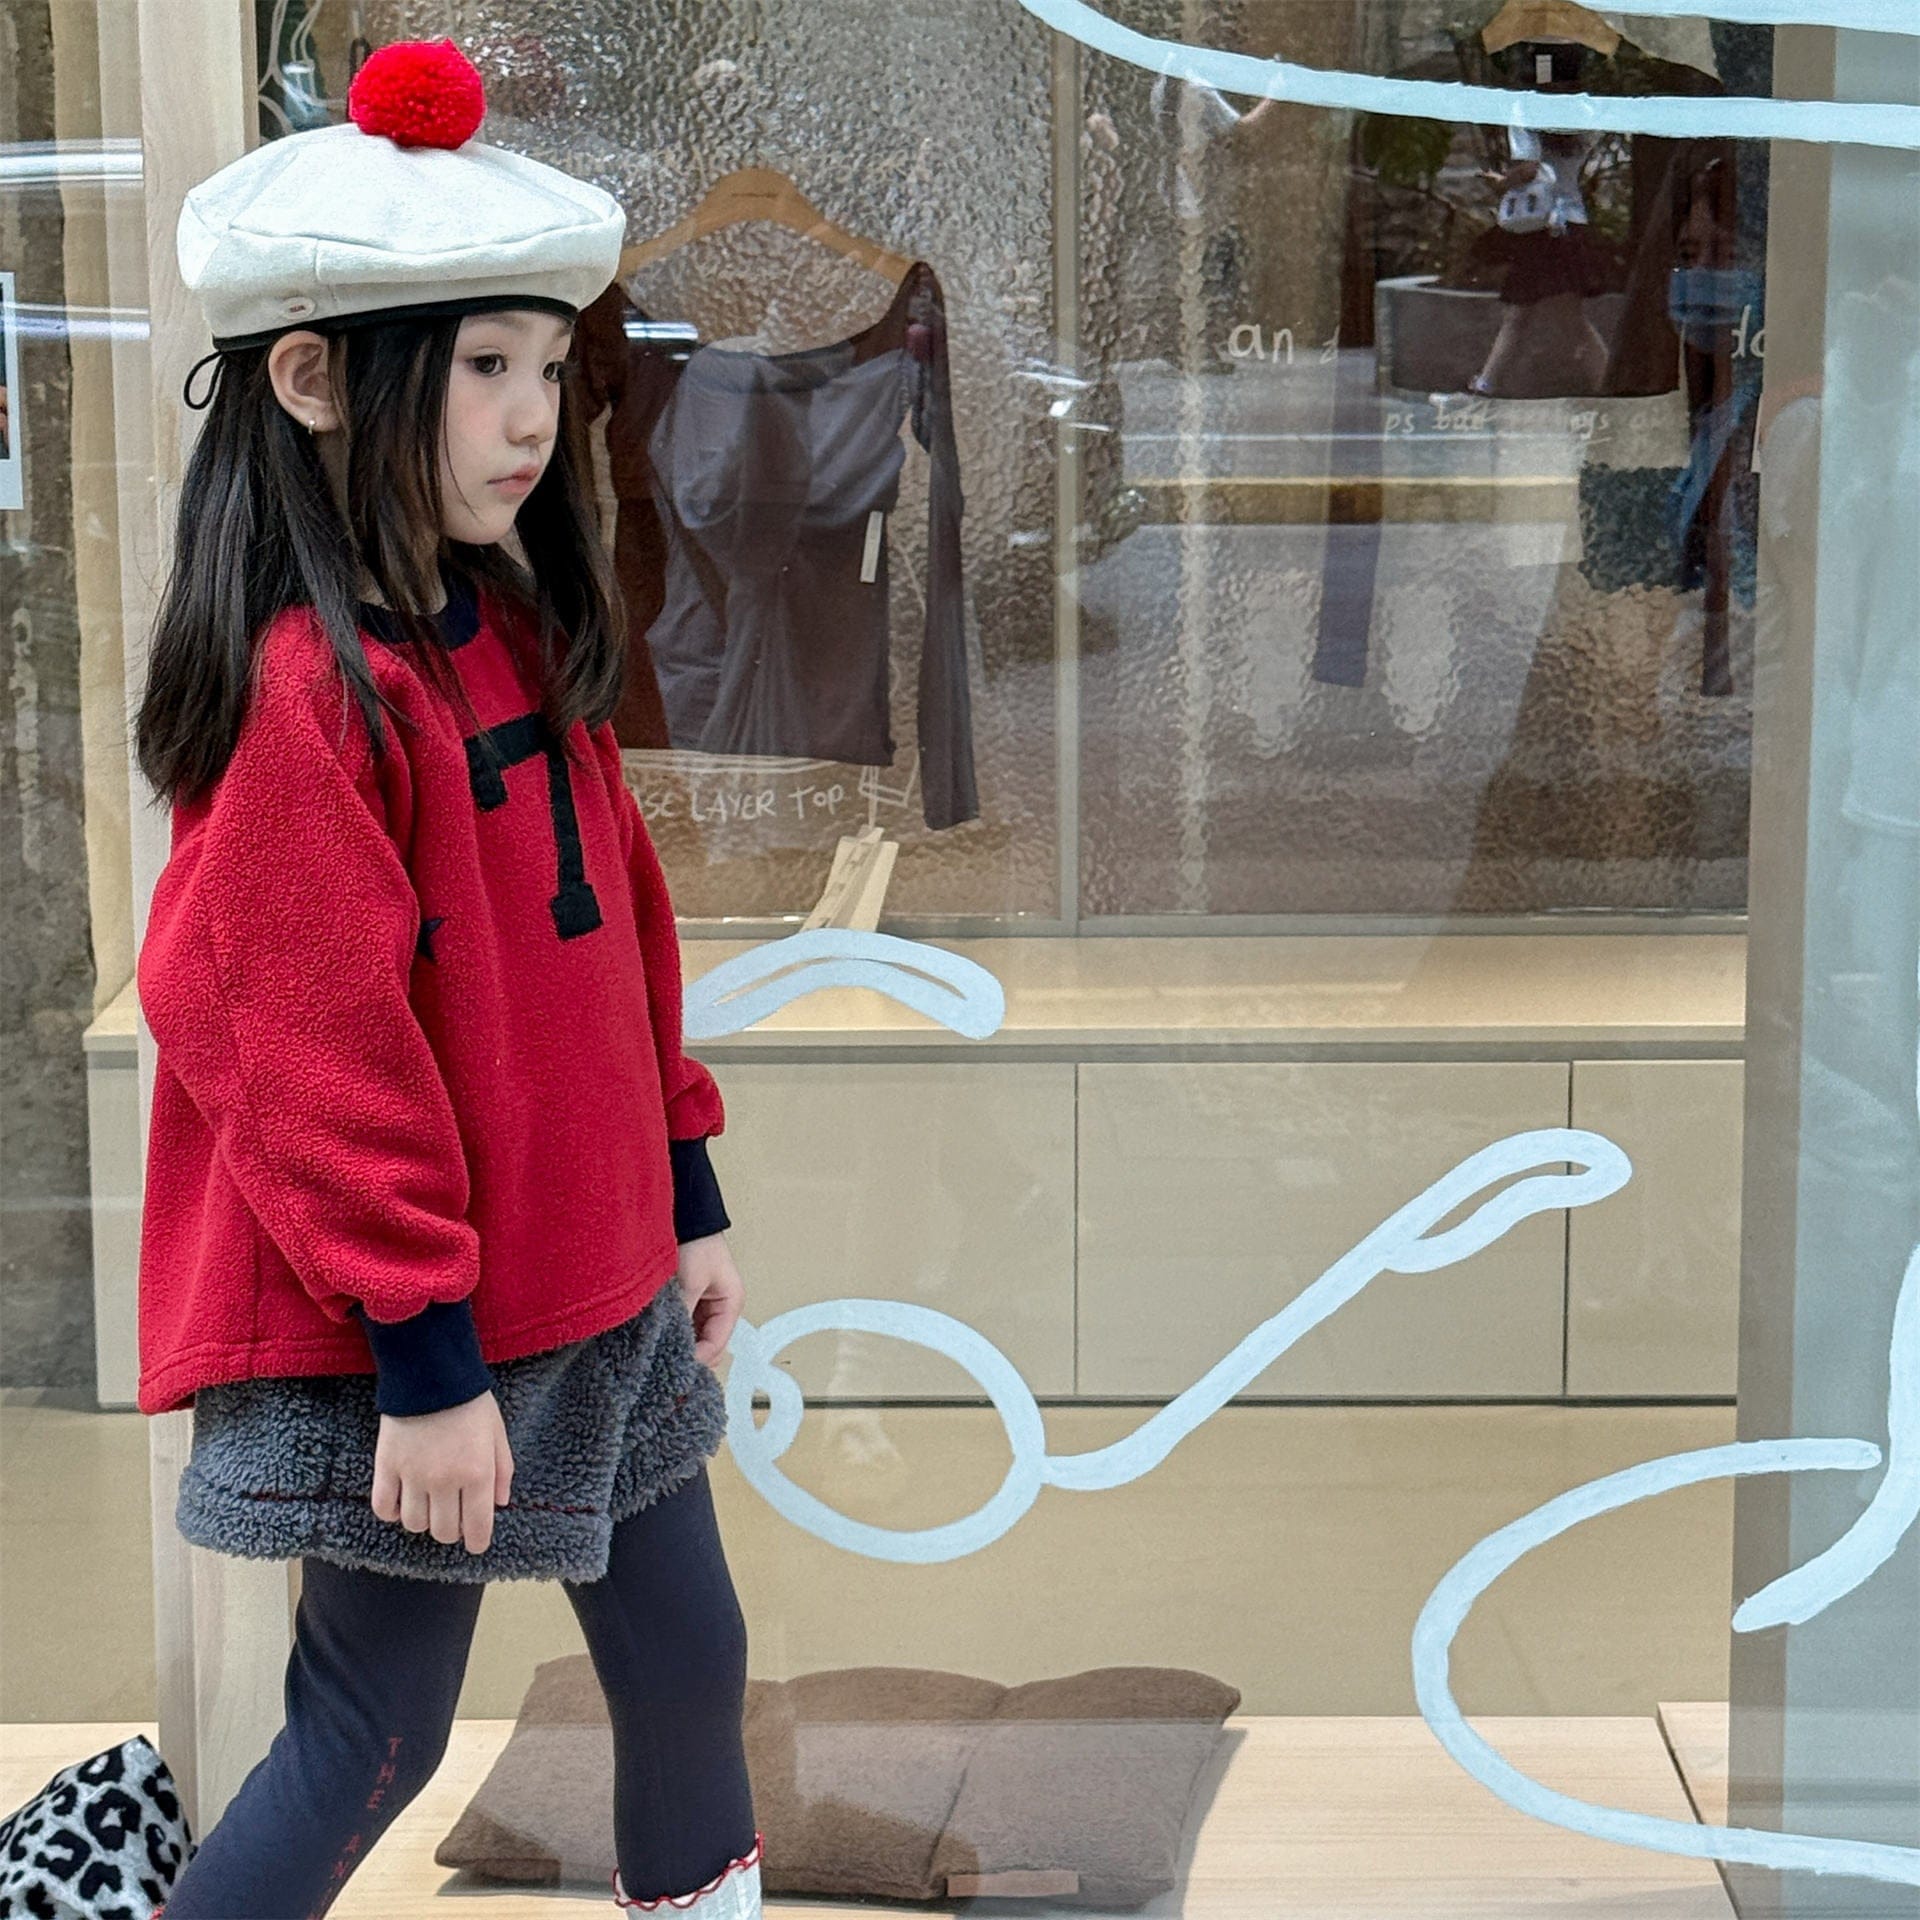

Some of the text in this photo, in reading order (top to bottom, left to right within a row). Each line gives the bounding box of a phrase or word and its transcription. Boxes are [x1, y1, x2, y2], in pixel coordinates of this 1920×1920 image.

[634, 785, 677, 821] SE
[691, 788, 777, 823] LAYER
[366, 1736, 403, 1810] THE
